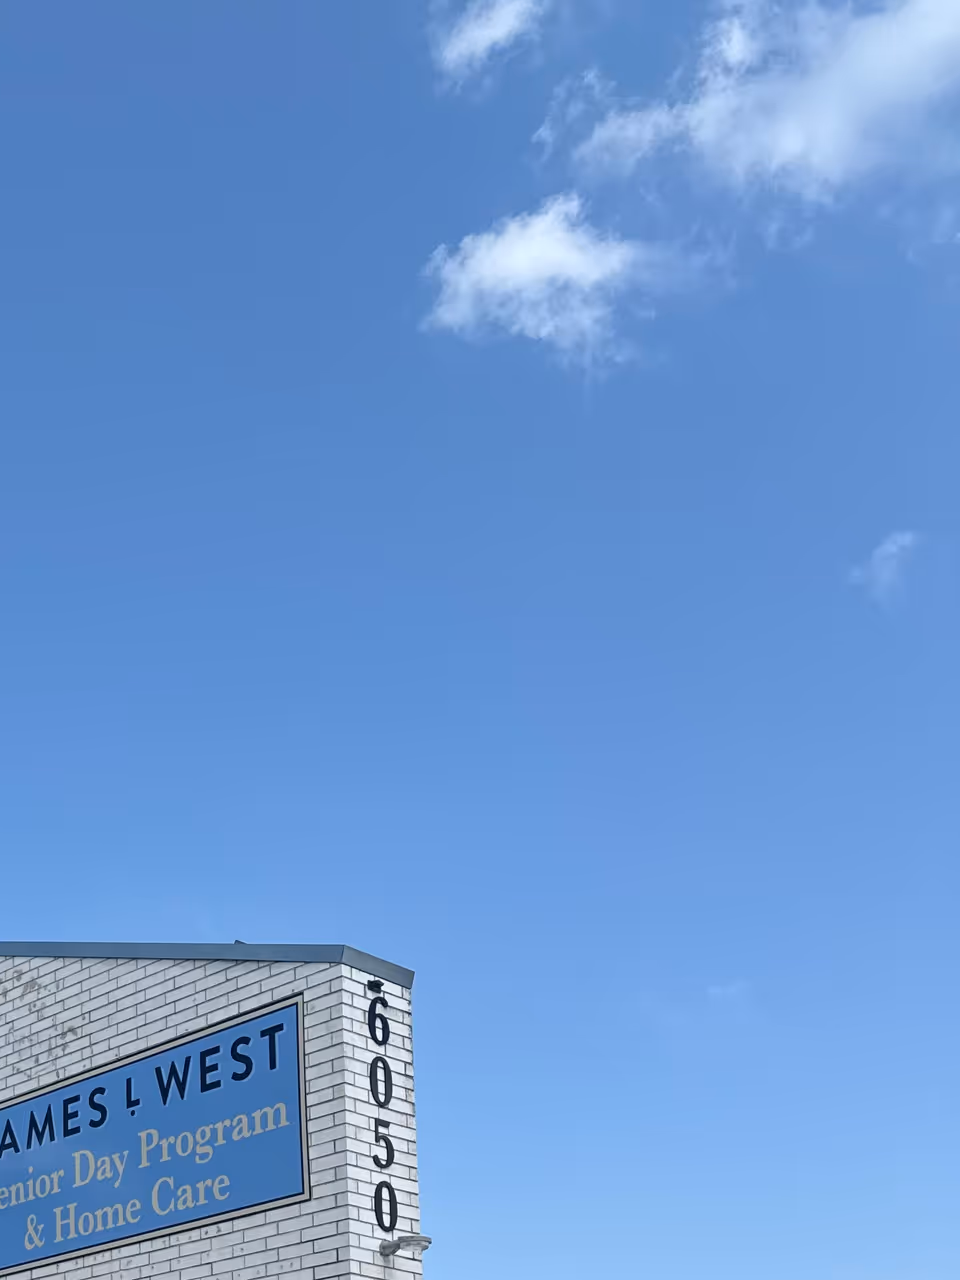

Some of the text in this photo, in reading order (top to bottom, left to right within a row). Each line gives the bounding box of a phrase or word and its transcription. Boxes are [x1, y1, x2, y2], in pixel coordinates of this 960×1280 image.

[154, 1023, 285, 1106] WEST
[72, 1149, 129, 1188] Day
[138, 1102, 290, 1165] Program
[368, 996, 398, 1233] 6050
[24, 1173, 231, 1251] & Home Care
